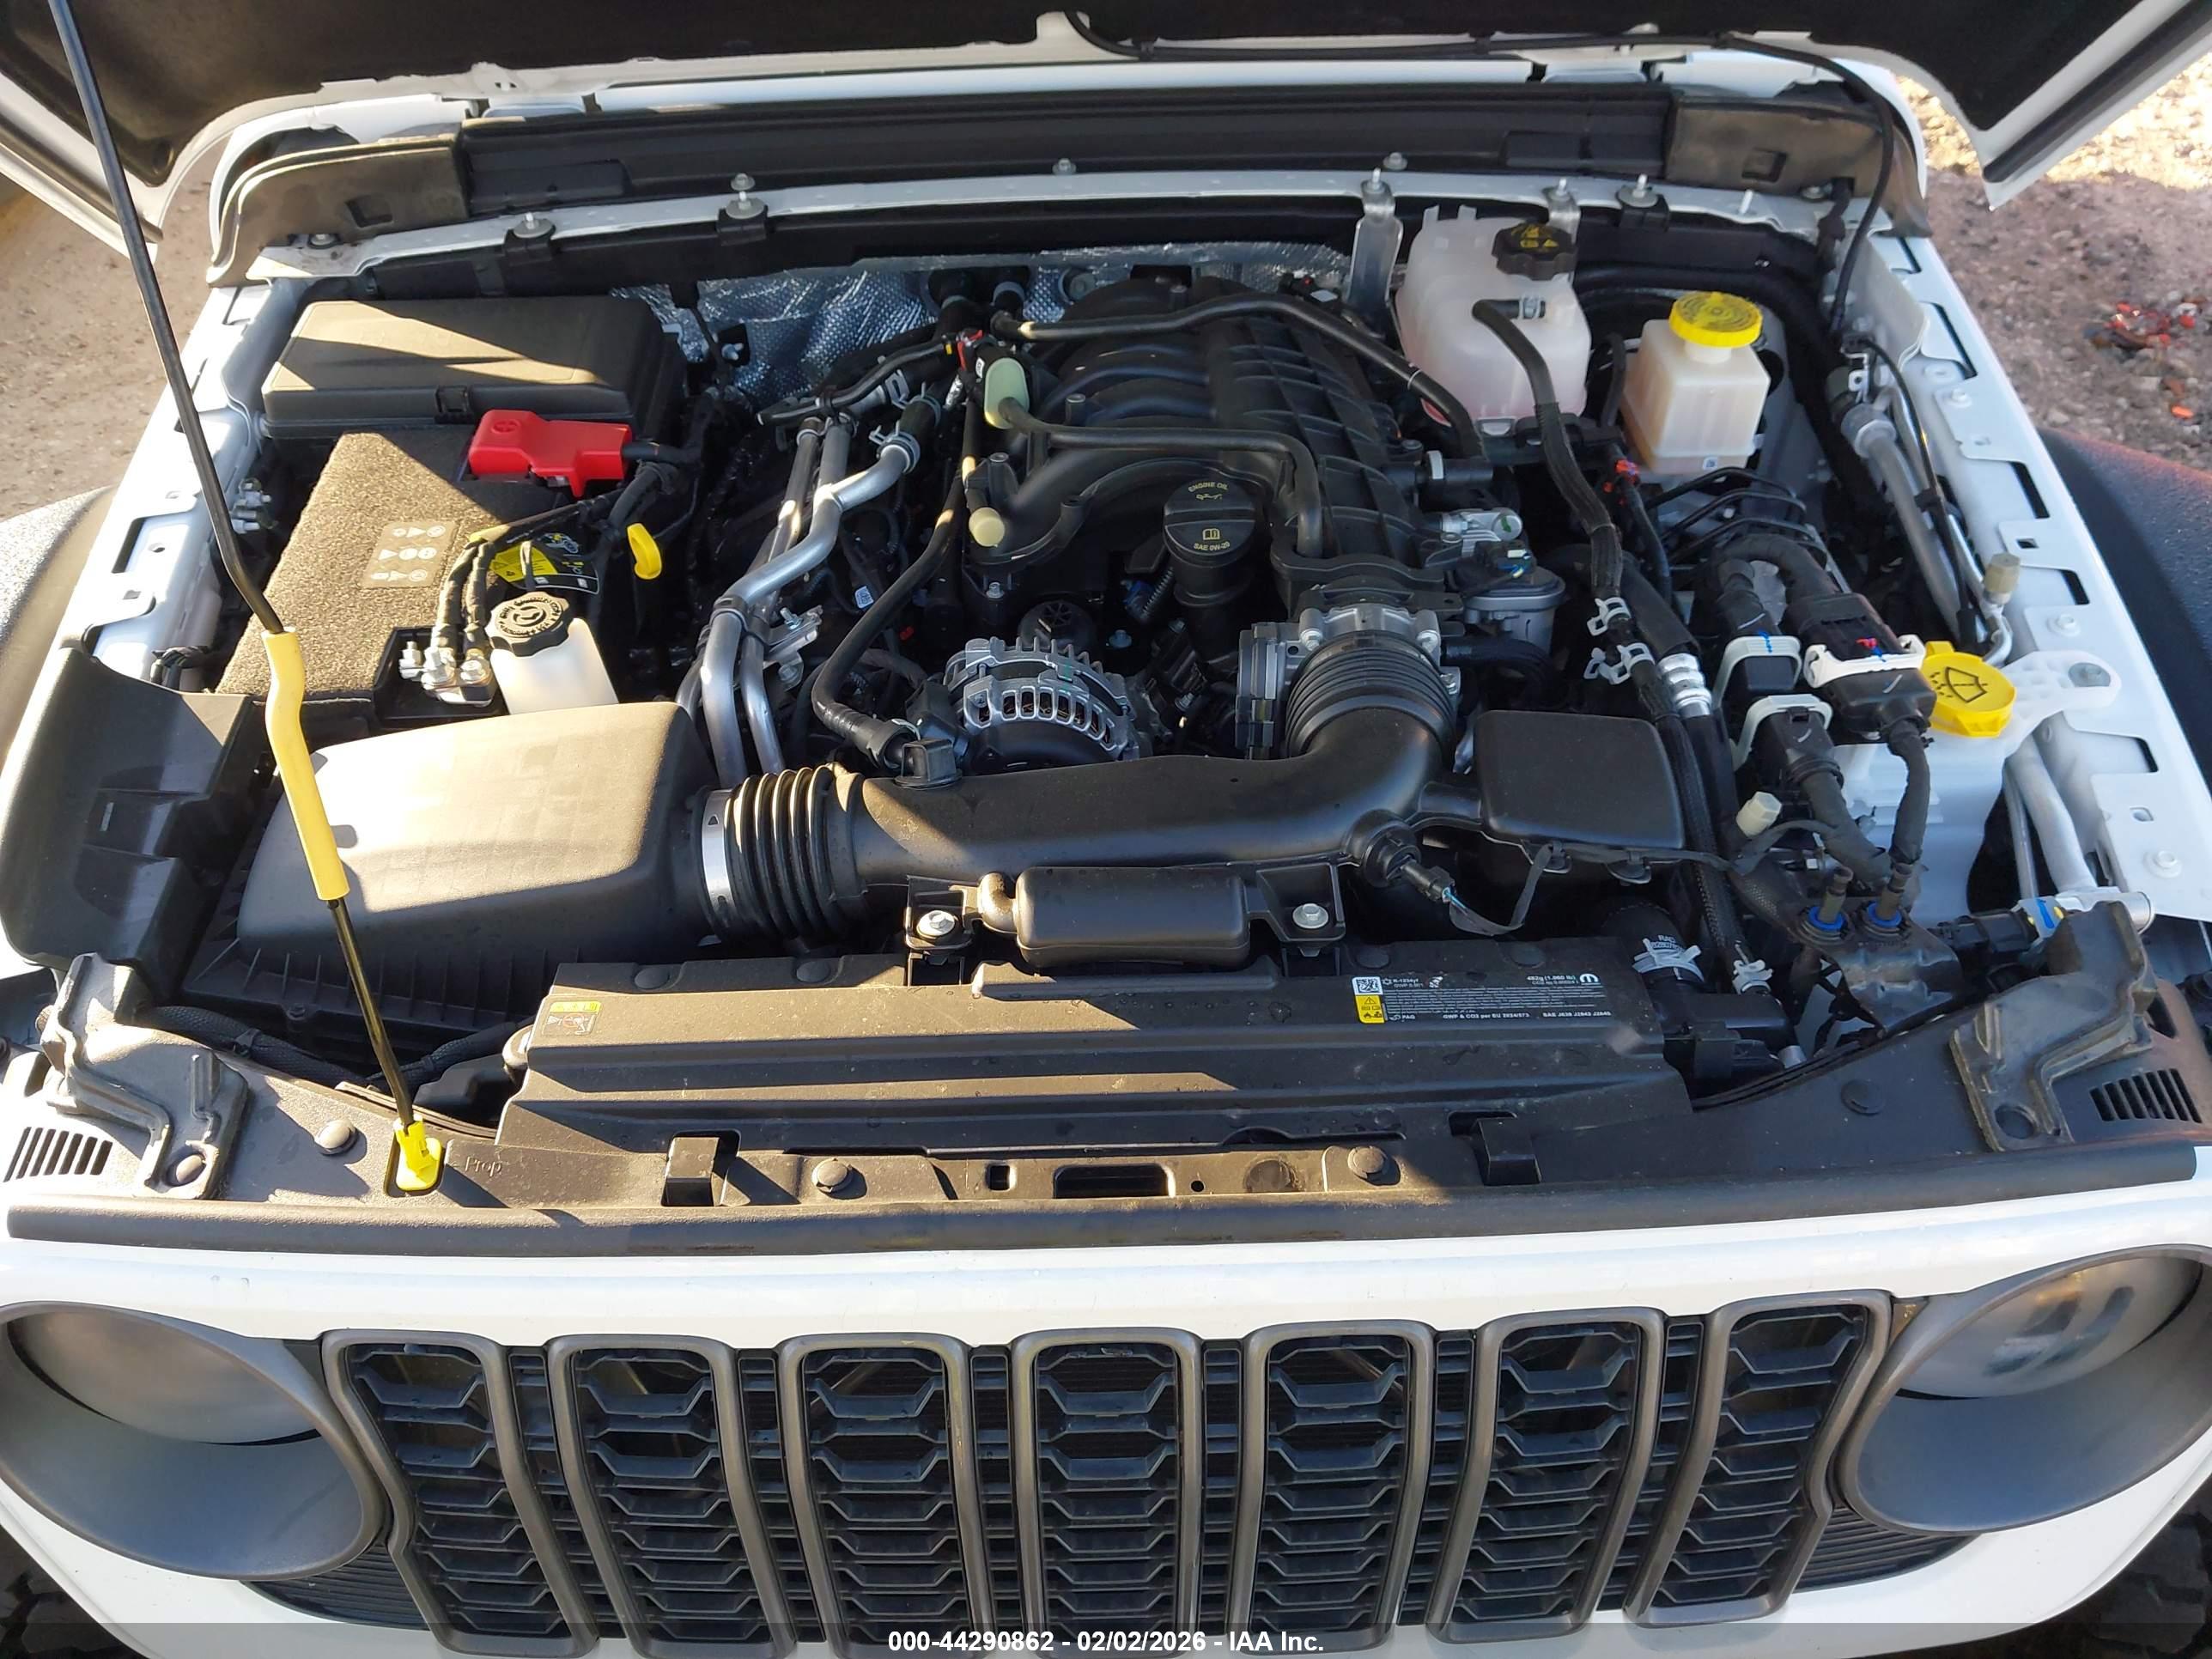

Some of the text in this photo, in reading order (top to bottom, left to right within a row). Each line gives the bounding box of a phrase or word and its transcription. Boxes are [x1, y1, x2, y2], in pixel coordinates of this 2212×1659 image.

[1188, 482, 1216, 492] ENGINE
[1209, 541, 1231, 551] 0W-20
[465, 1156, 501, 1176] Prop
